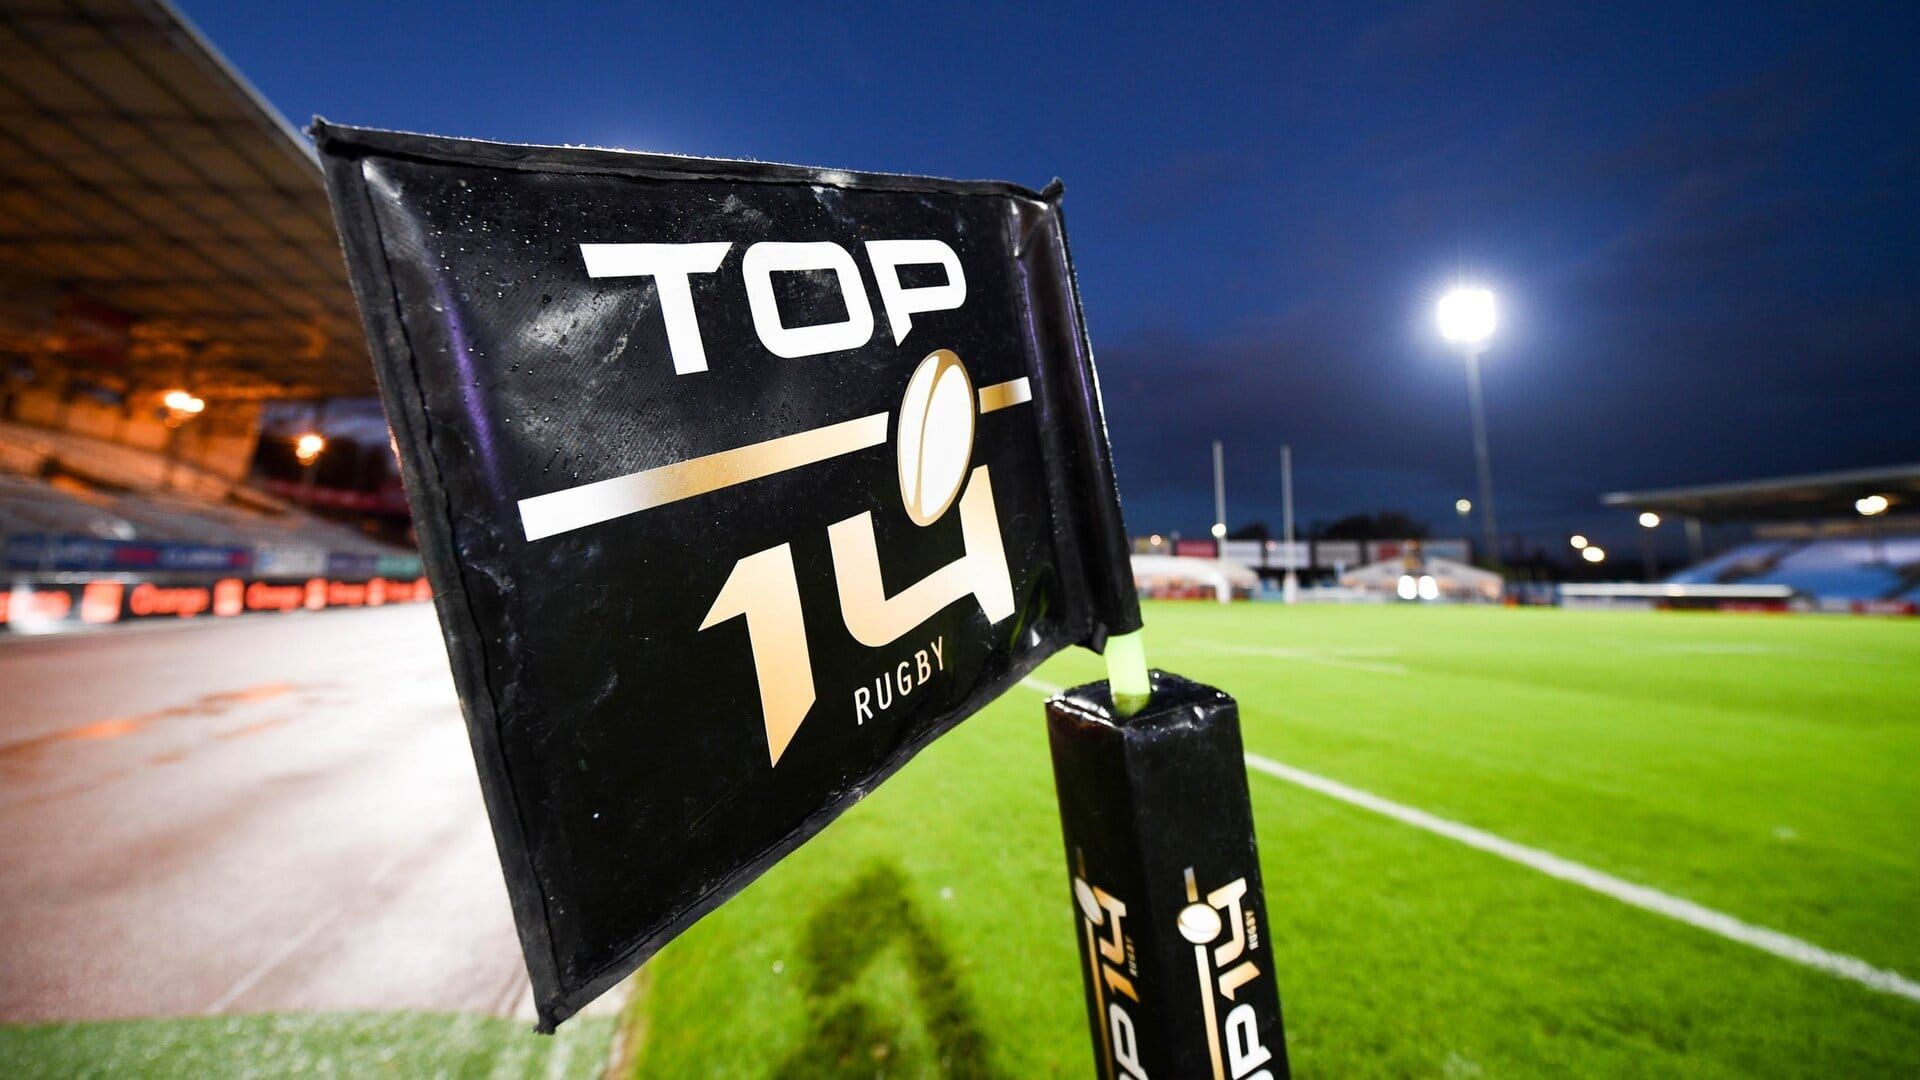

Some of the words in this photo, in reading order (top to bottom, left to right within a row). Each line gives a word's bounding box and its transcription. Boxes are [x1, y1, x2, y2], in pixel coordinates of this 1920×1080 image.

[579, 239, 967, 376] TOP
[698, 464, 1016, 768] 14
[853, 636, 944, 725] RUGBY
[1092, 886, 1140, 1003] 14
[1206, 877, 1261, 1001] 14
